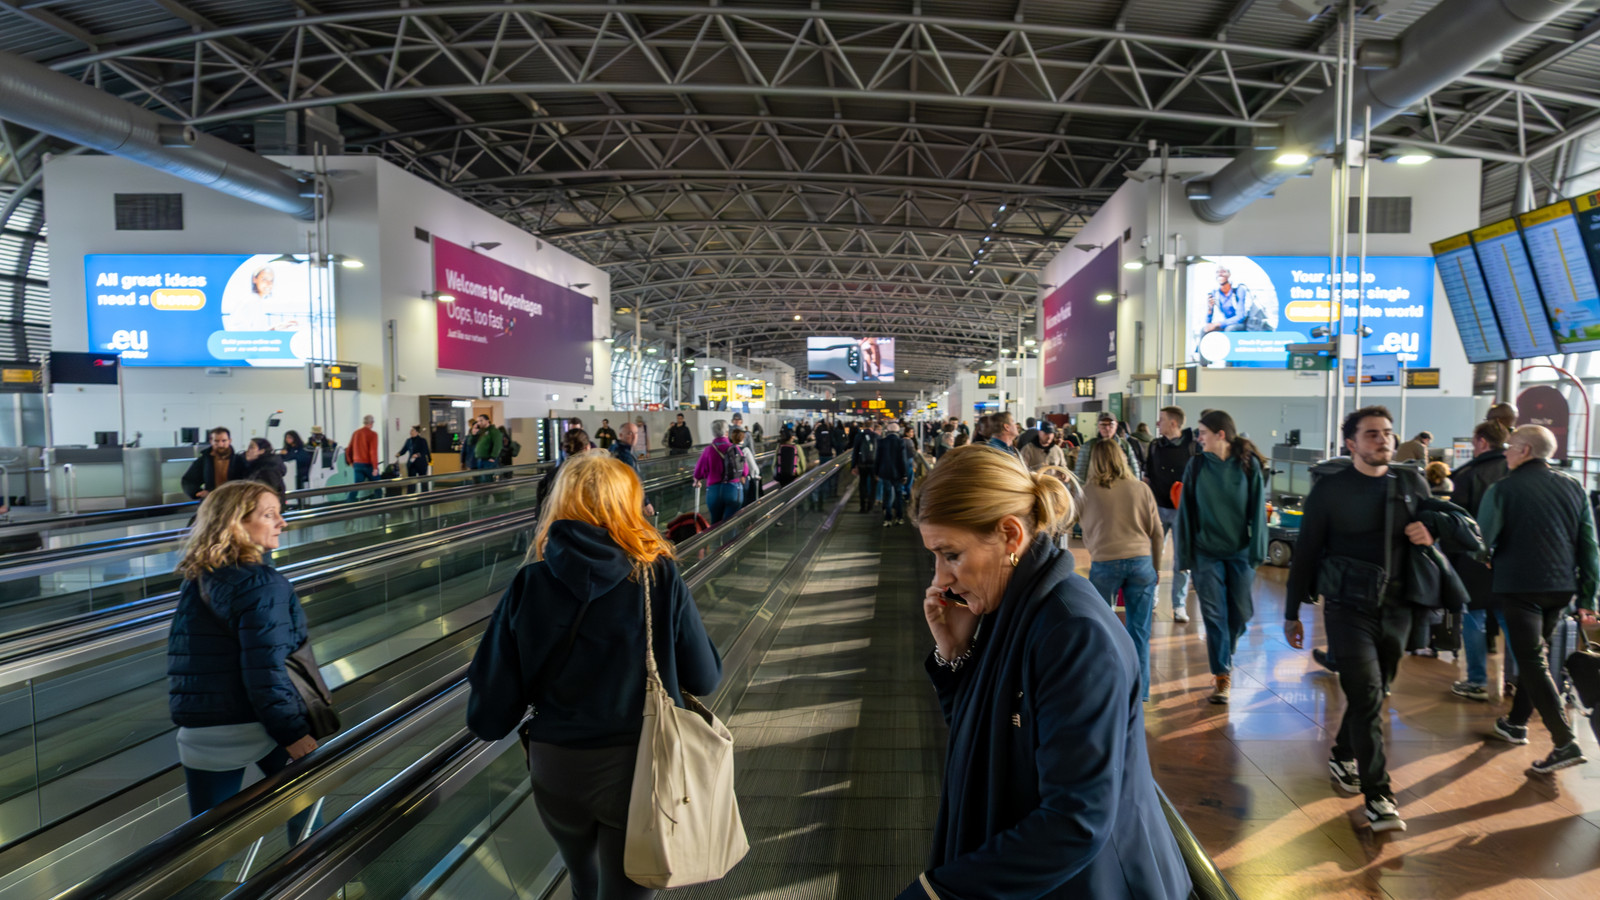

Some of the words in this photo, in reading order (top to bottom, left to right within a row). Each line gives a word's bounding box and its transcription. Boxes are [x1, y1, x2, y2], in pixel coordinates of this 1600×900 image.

[96, 272, 118, 287] All
[121, 273, 162, 290] great
[165, 272, 207, 287] ideas
[1290, 270, 1325, 283] Your
[1360, 271, 1376, 283] to
[97, 291, 136, 306] need
[138, 294, 149, 306] a
[156, 291, 200, 306] home
[445, 268, 488, 299] Welcome
[488, 285, 498, 302] to
[499, 287, 543, 317] Copenhagen
[1290, 286, 1314, 299] the
[1315, 286, 1365, 302] lagest
[1366, 286, 1410, 302] single
[447, 301, 473, 325] Oops,
[473, 308, 488, 326] too
[488, 309, 504, 330] fast
[1343, 304, 1358, 317] in
[1360, 304, 1383, 317] the
[1384, 304, 1424, 318] world
[107, 330, 148, 350] .eu
[1377, 332, 1419, 352] .eu
[978, 375, 997, 384] A47
